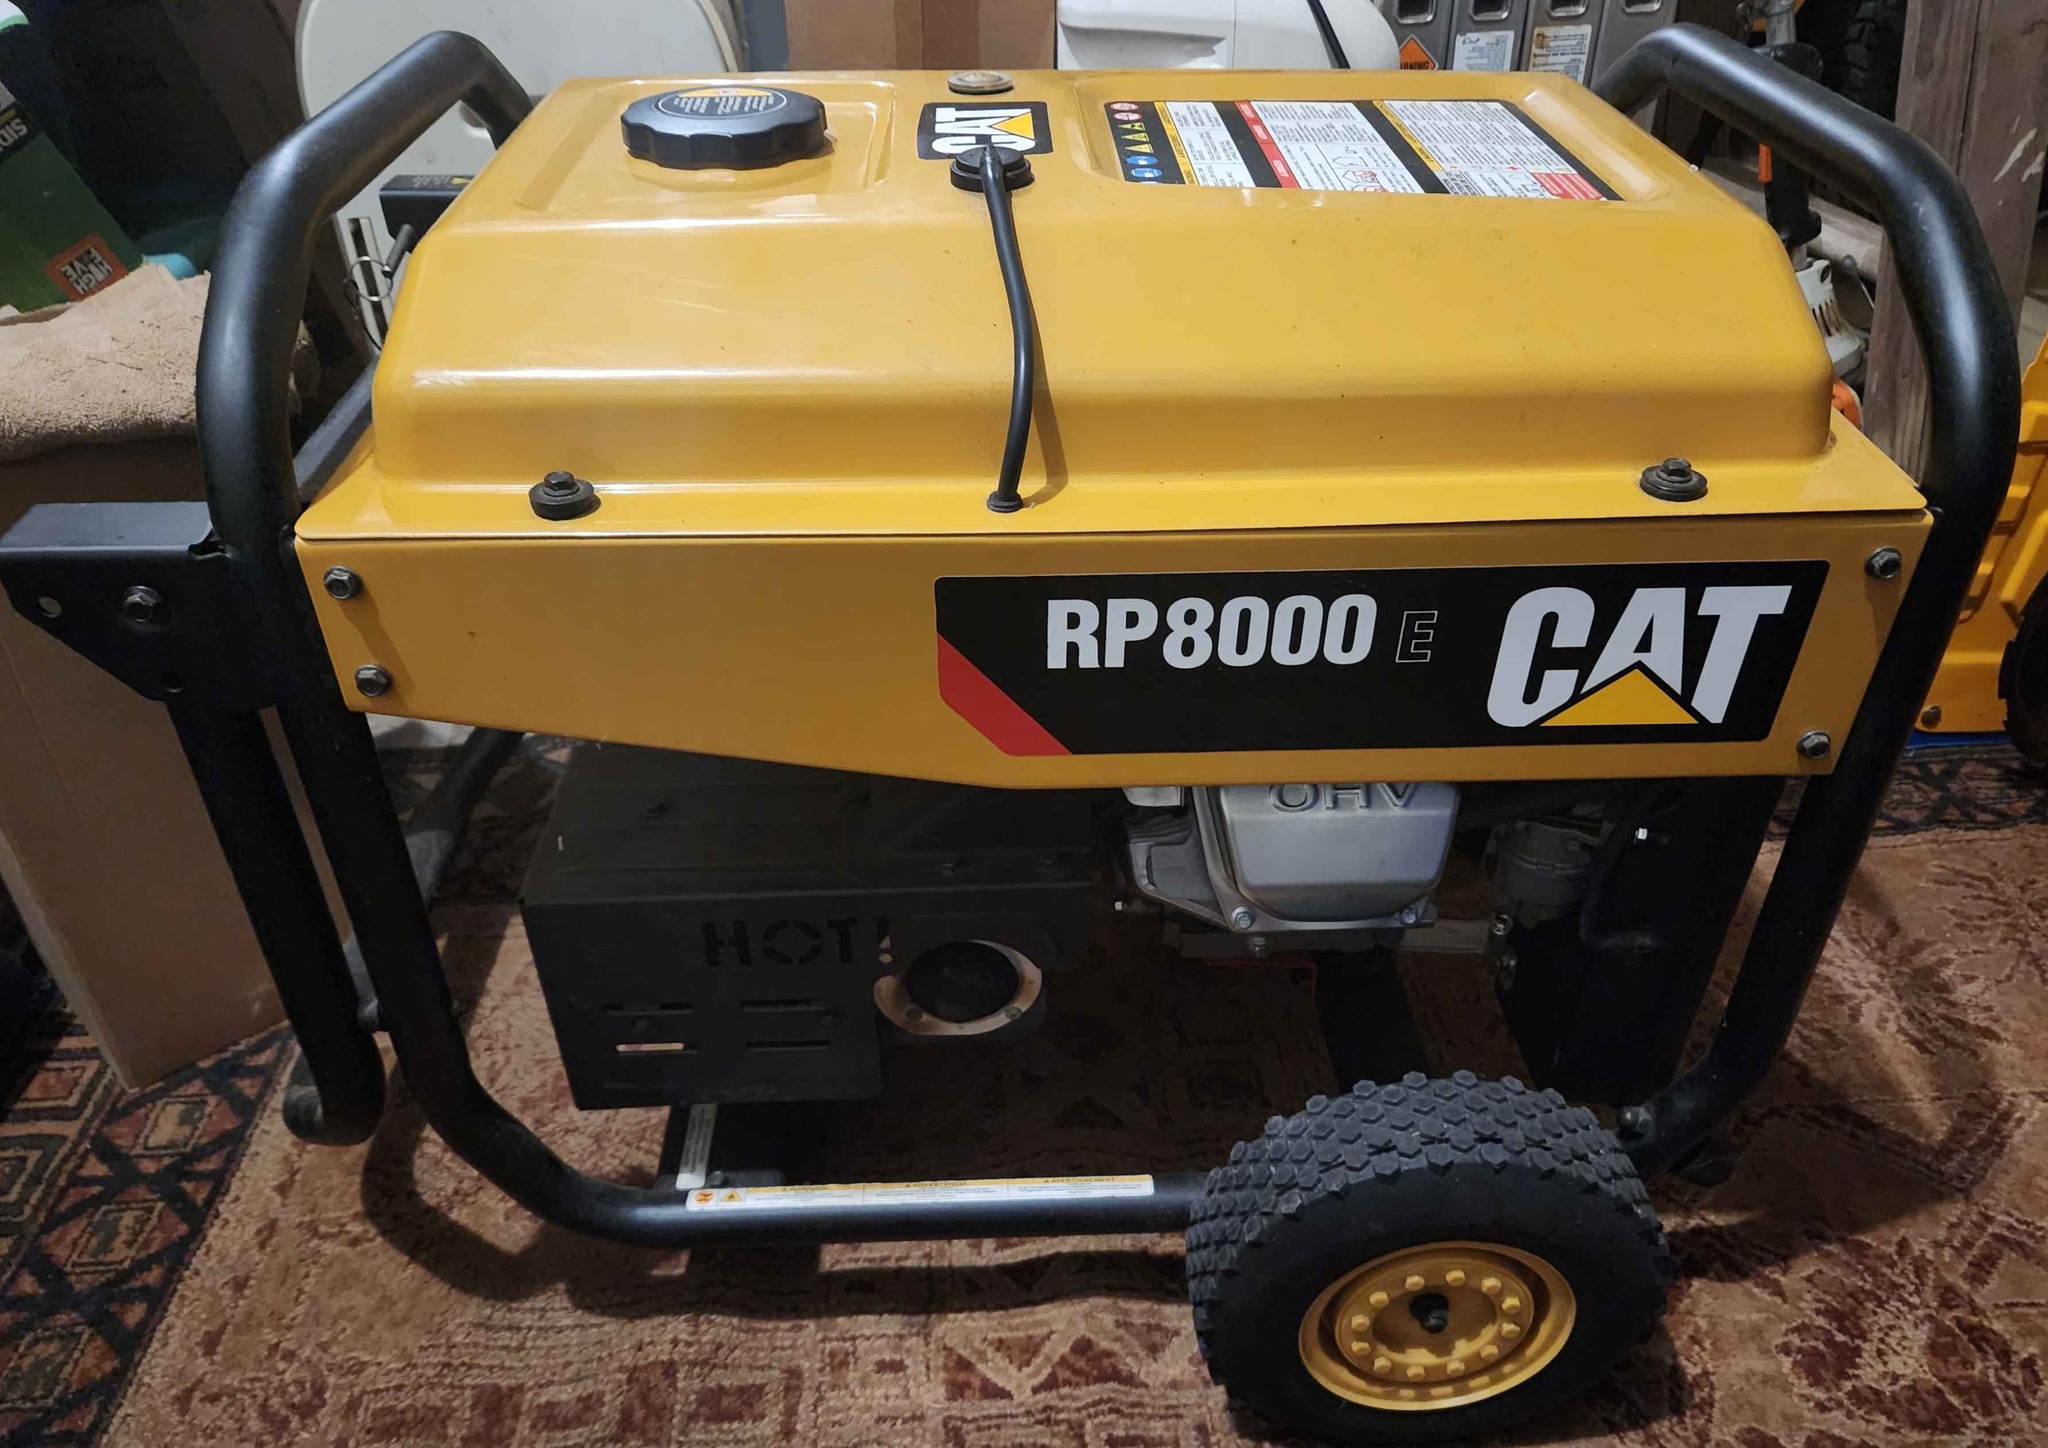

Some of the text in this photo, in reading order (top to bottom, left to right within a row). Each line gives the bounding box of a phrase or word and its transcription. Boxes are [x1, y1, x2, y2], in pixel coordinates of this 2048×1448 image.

[1046, 593, 1439, 669] RP8000 E
[1487, 585, 1793, 728] CAT
[1268, 782, 1420, 813] OHV
[701, 916, 893, 968] HOT!
